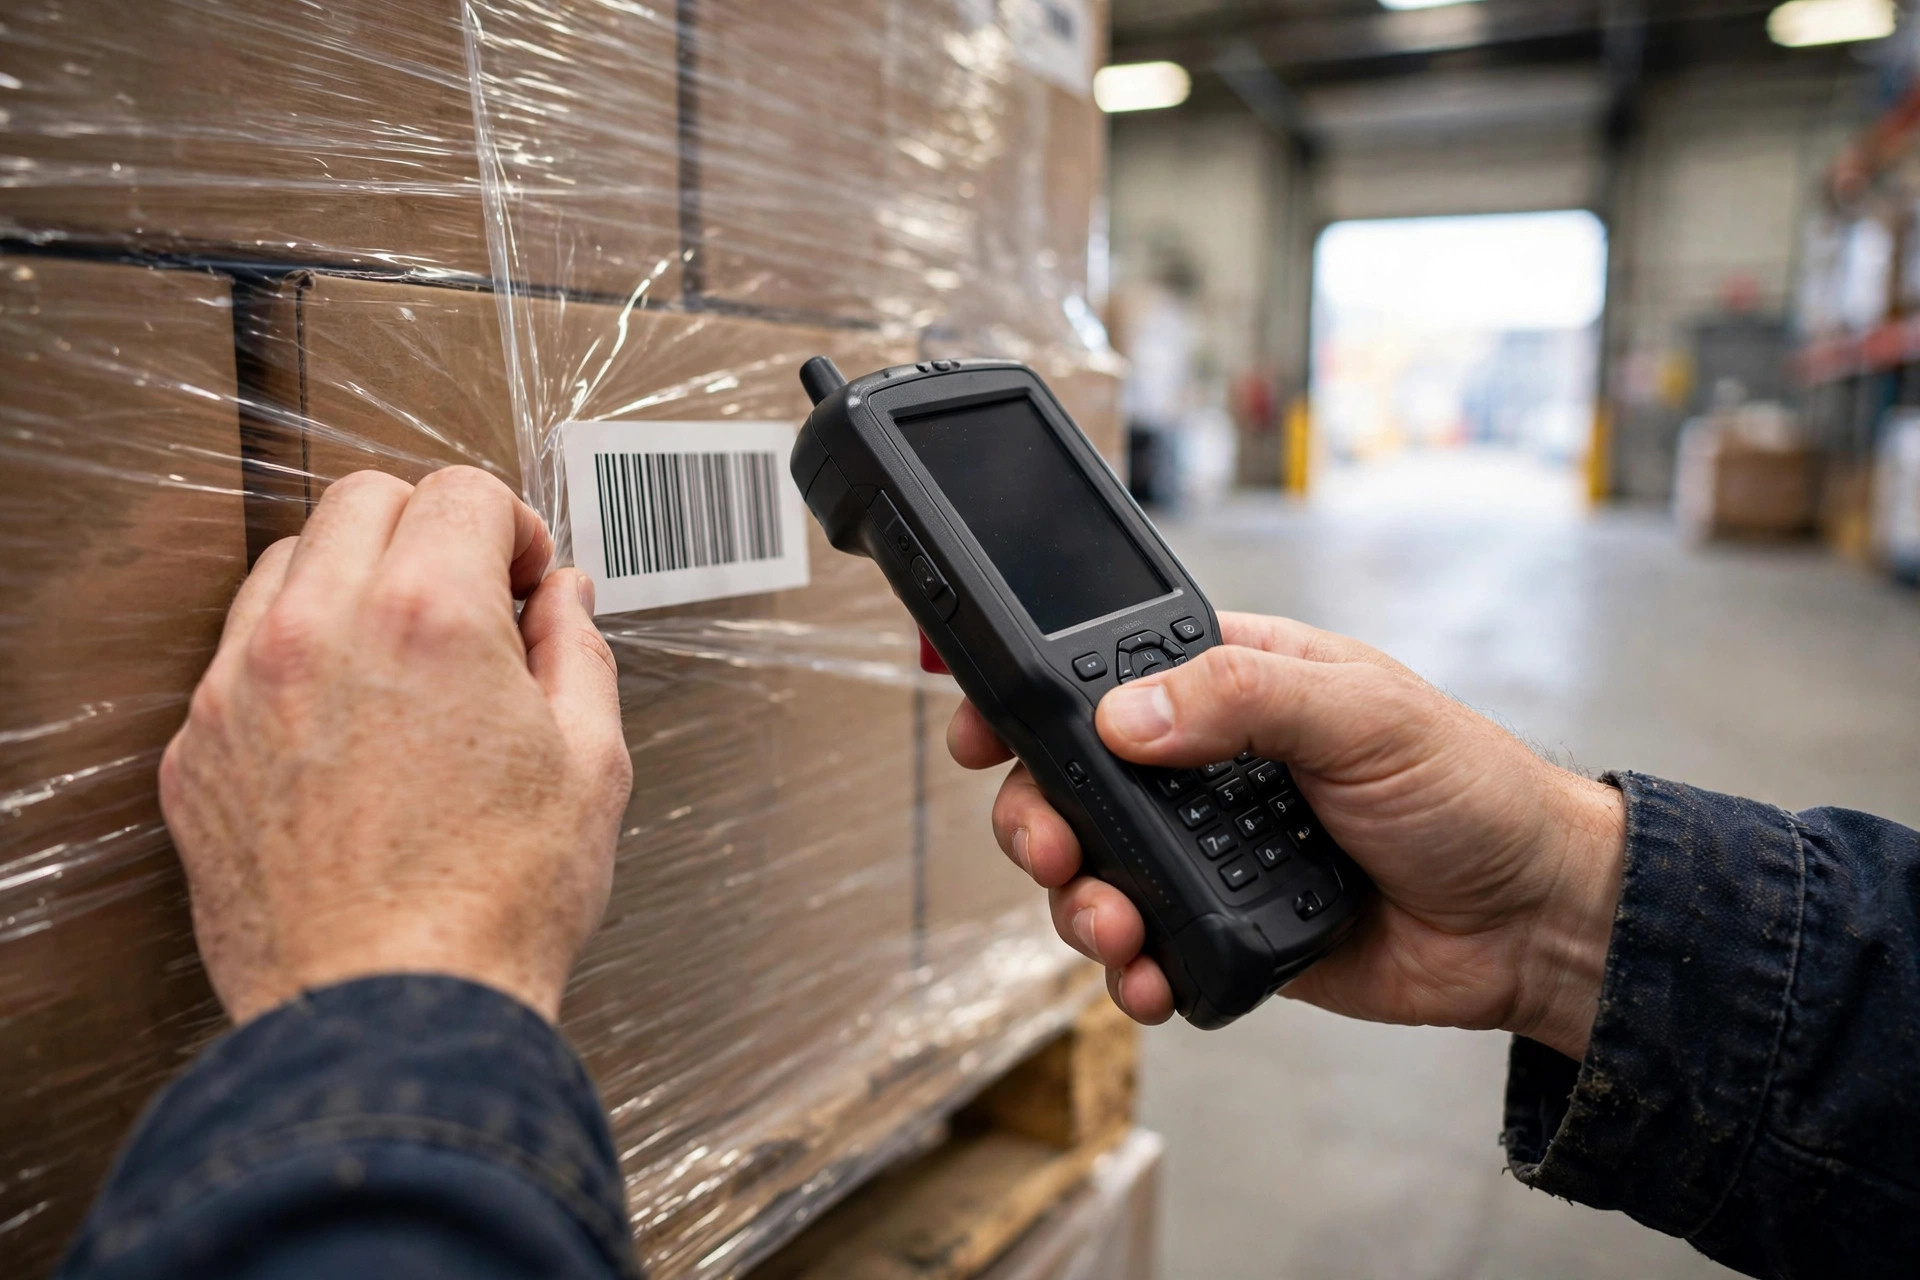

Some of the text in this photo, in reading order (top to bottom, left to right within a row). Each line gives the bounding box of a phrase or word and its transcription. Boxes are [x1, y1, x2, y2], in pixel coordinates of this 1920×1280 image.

[1257, 772, 1266, 783] 6
[1224, 789, 1234, 801] 5
[1190, 807, 1201, 819] 4
[1277, 801, 1286, 813] 9
[1245, 819, 1255, 831] 8
[1207, 836, 1218, 851] 7
[1265, 848, 1275, 860] 0
